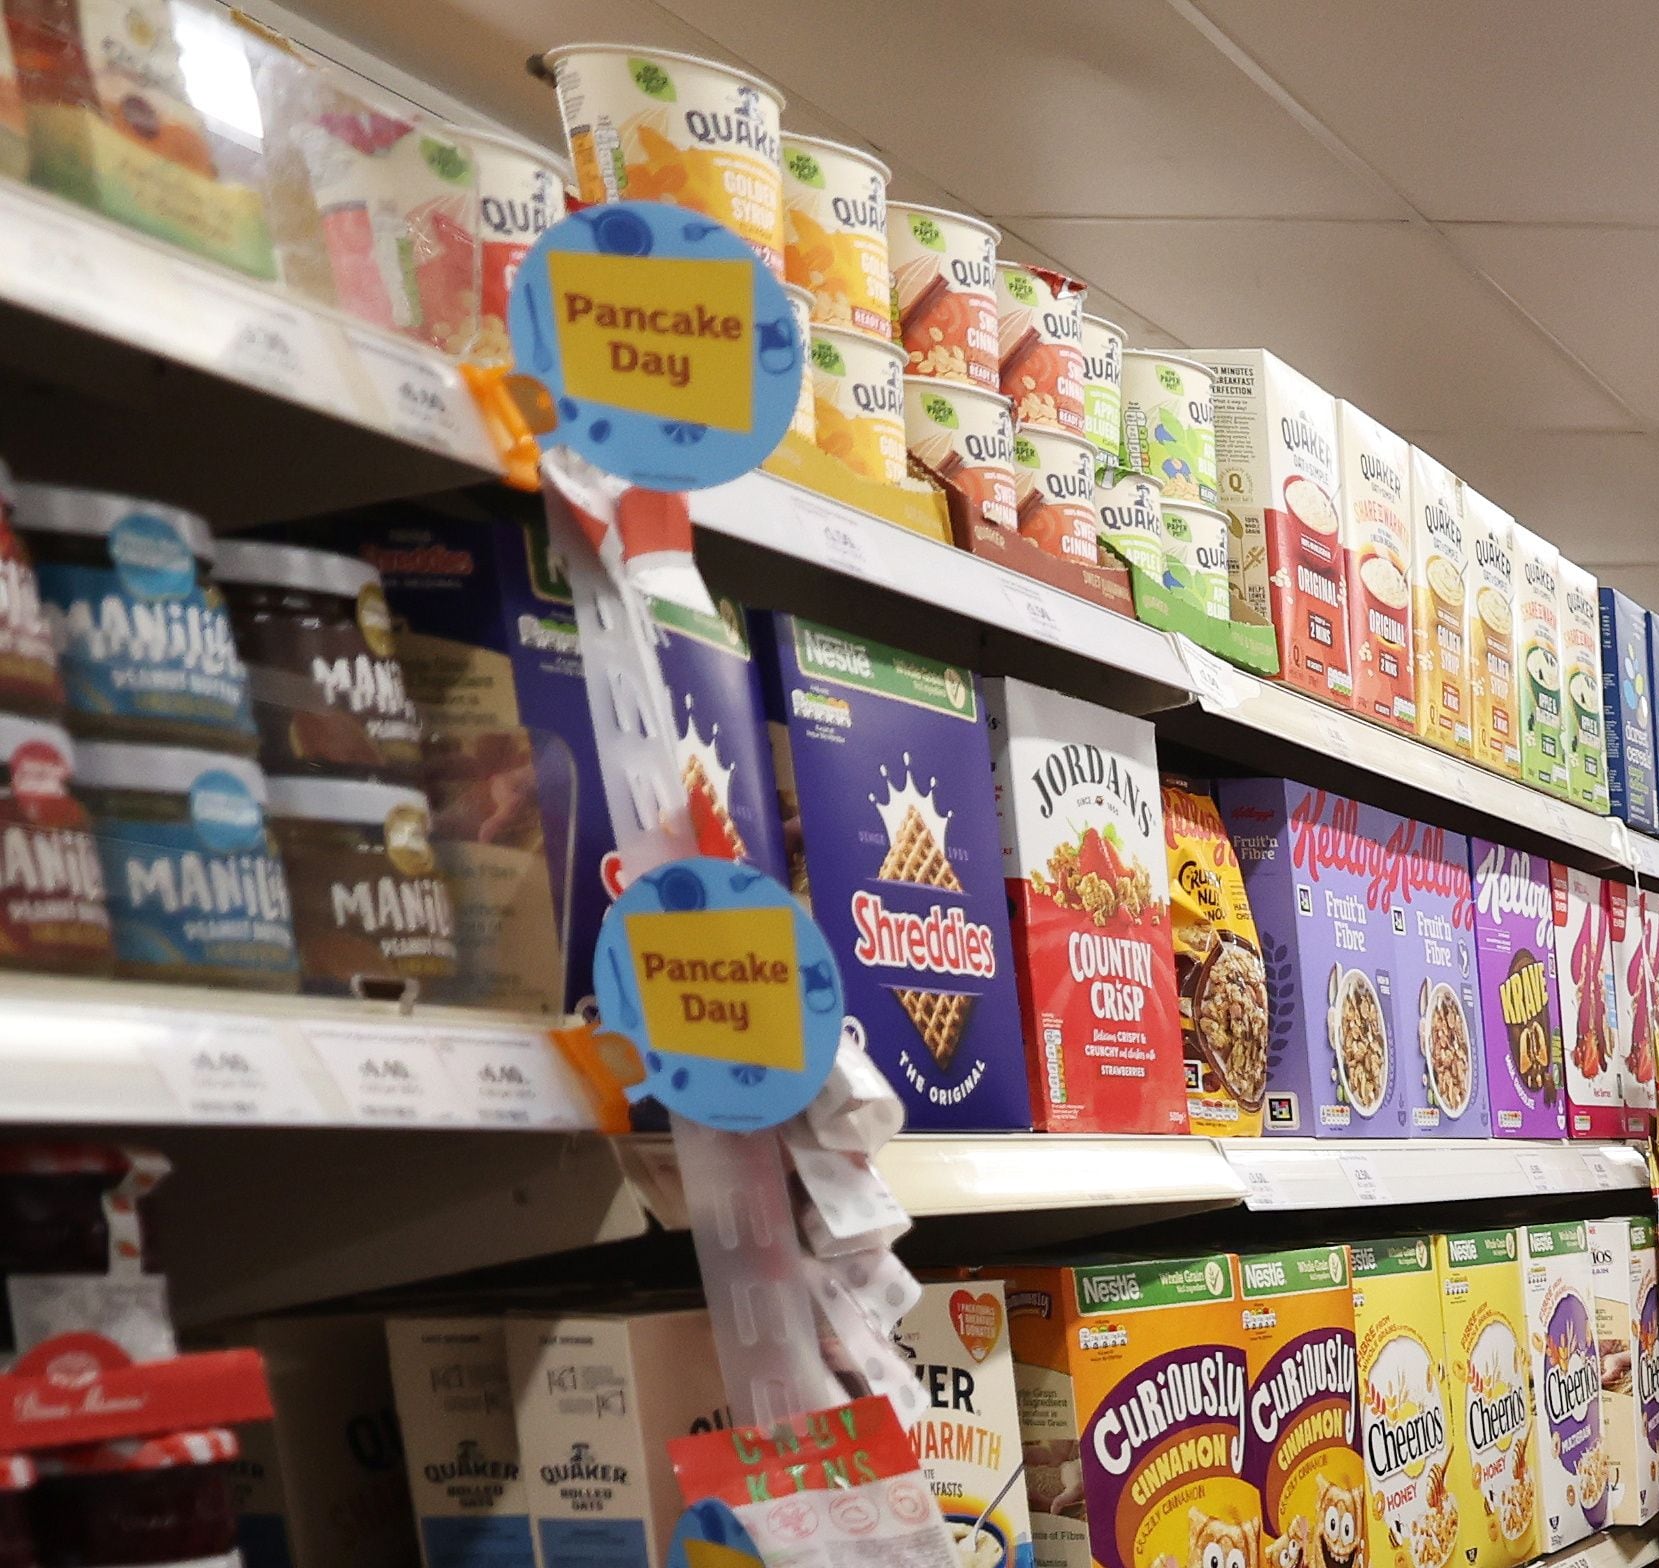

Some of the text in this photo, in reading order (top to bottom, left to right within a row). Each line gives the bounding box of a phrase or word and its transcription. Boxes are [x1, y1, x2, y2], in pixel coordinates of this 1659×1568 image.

[565, 290, 745, 343] Pancake
[607, 341, 693, 389] Day
[1280, 416, 1333, 473] QUAKER
[1030, 742, 1154, 839] JORDANS
[1241, 848, 1275, 861] Fibre
[851, 888, 996, 980] Shreddies
[1068, 931, 1154, 989] COUNTRY
[1334, 921, 1367, 952] Fibre
[1424, 937, 1452, 967] Fibre
[642, 951, 790, 985] Pancake
[1499, 961, 1549, 1025] KRAVE
[679, 992, 751, 1031] Day
[929, 1058, 986, 1107] ORIGINAL
[1548, 1358, 1599, 1421] Cheerios
[1277, 1408, 1343, 1472] CINNAMON
[1368, 1404, 1443, 1477] Cheerios
[1469, 1384, 1525, 1452] Cheerios
[1132, 1434, 1226, 1506] CINNAMON
[1483, 1455, 1507, 1479] HONEY
[1386, 1484, 1418, 1510] HONEY
